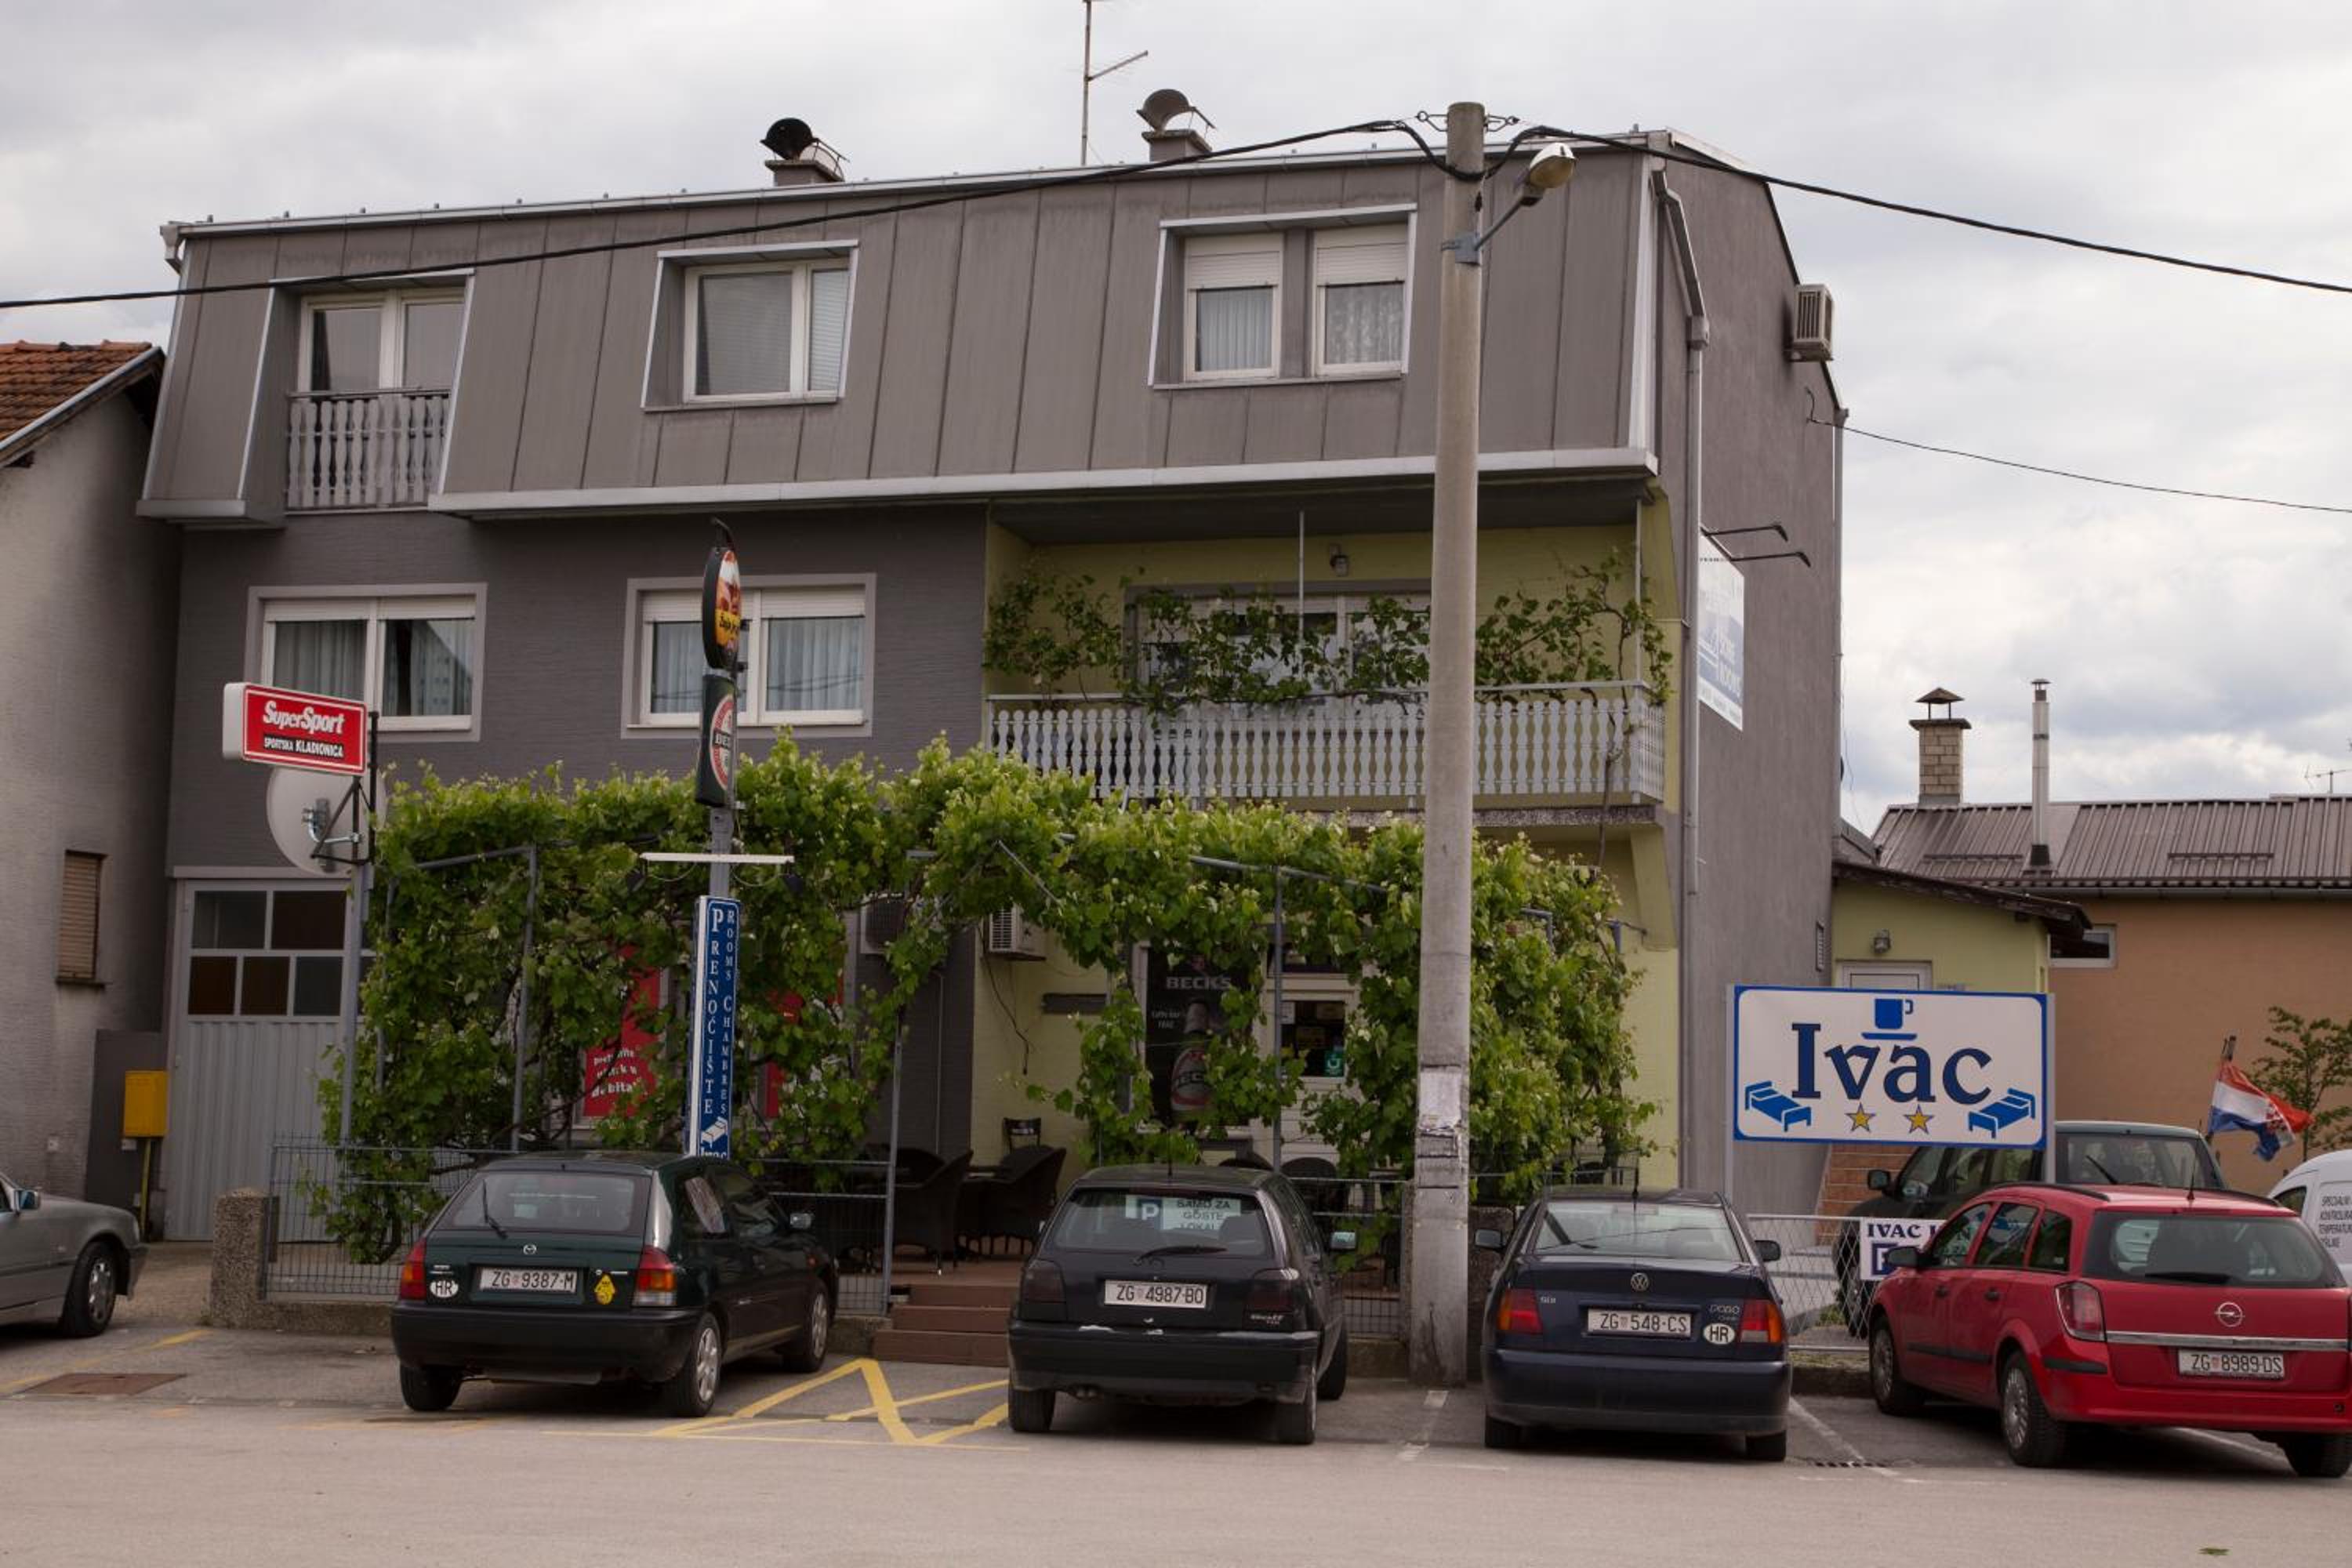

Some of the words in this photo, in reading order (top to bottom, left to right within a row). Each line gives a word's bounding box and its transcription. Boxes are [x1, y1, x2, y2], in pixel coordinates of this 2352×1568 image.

[263, 700, 345, 734] SuperSport
[296, 739, 343, 757] KLADIONICA
[725, 909, 735, 981] ROOMS
[1791, 1023, 1993, 1105] Ivac
[1867, 1224, 1922, 1238] IVAC
[435, 1280, 452, 1296] HR
[491, 1271, 511, 1288] ZG
[1116, 1285, 1134, 1301] ZG
[1600, 1312, 1619, 1330] ZG
[1710, 1325, 1729, 1342] HR
[2191, 1354, 2211, 1370] ZG
